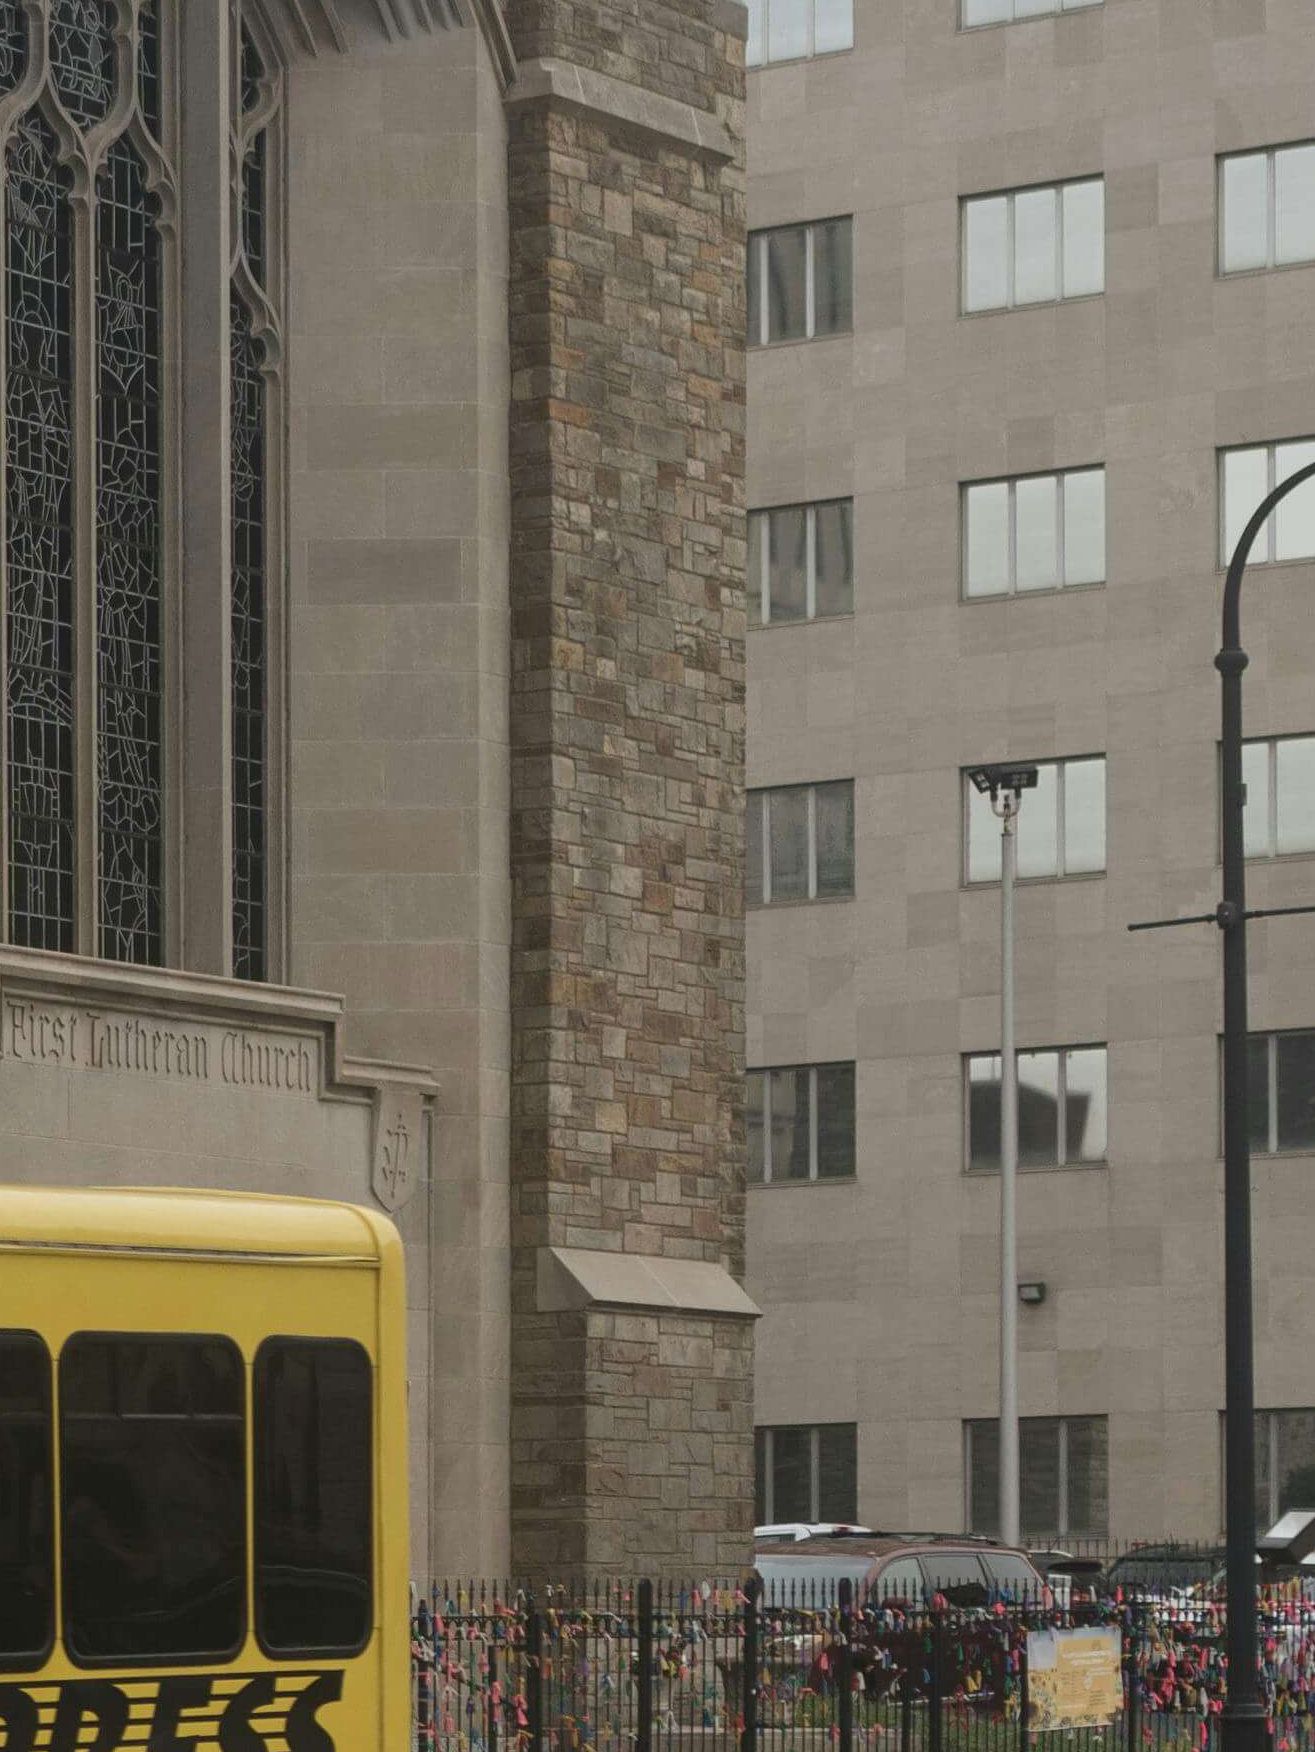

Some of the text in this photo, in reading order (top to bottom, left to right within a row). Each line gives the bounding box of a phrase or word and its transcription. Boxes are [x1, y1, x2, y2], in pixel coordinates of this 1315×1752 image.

[7, 1000, 311, 1092] First Lutheran Church
